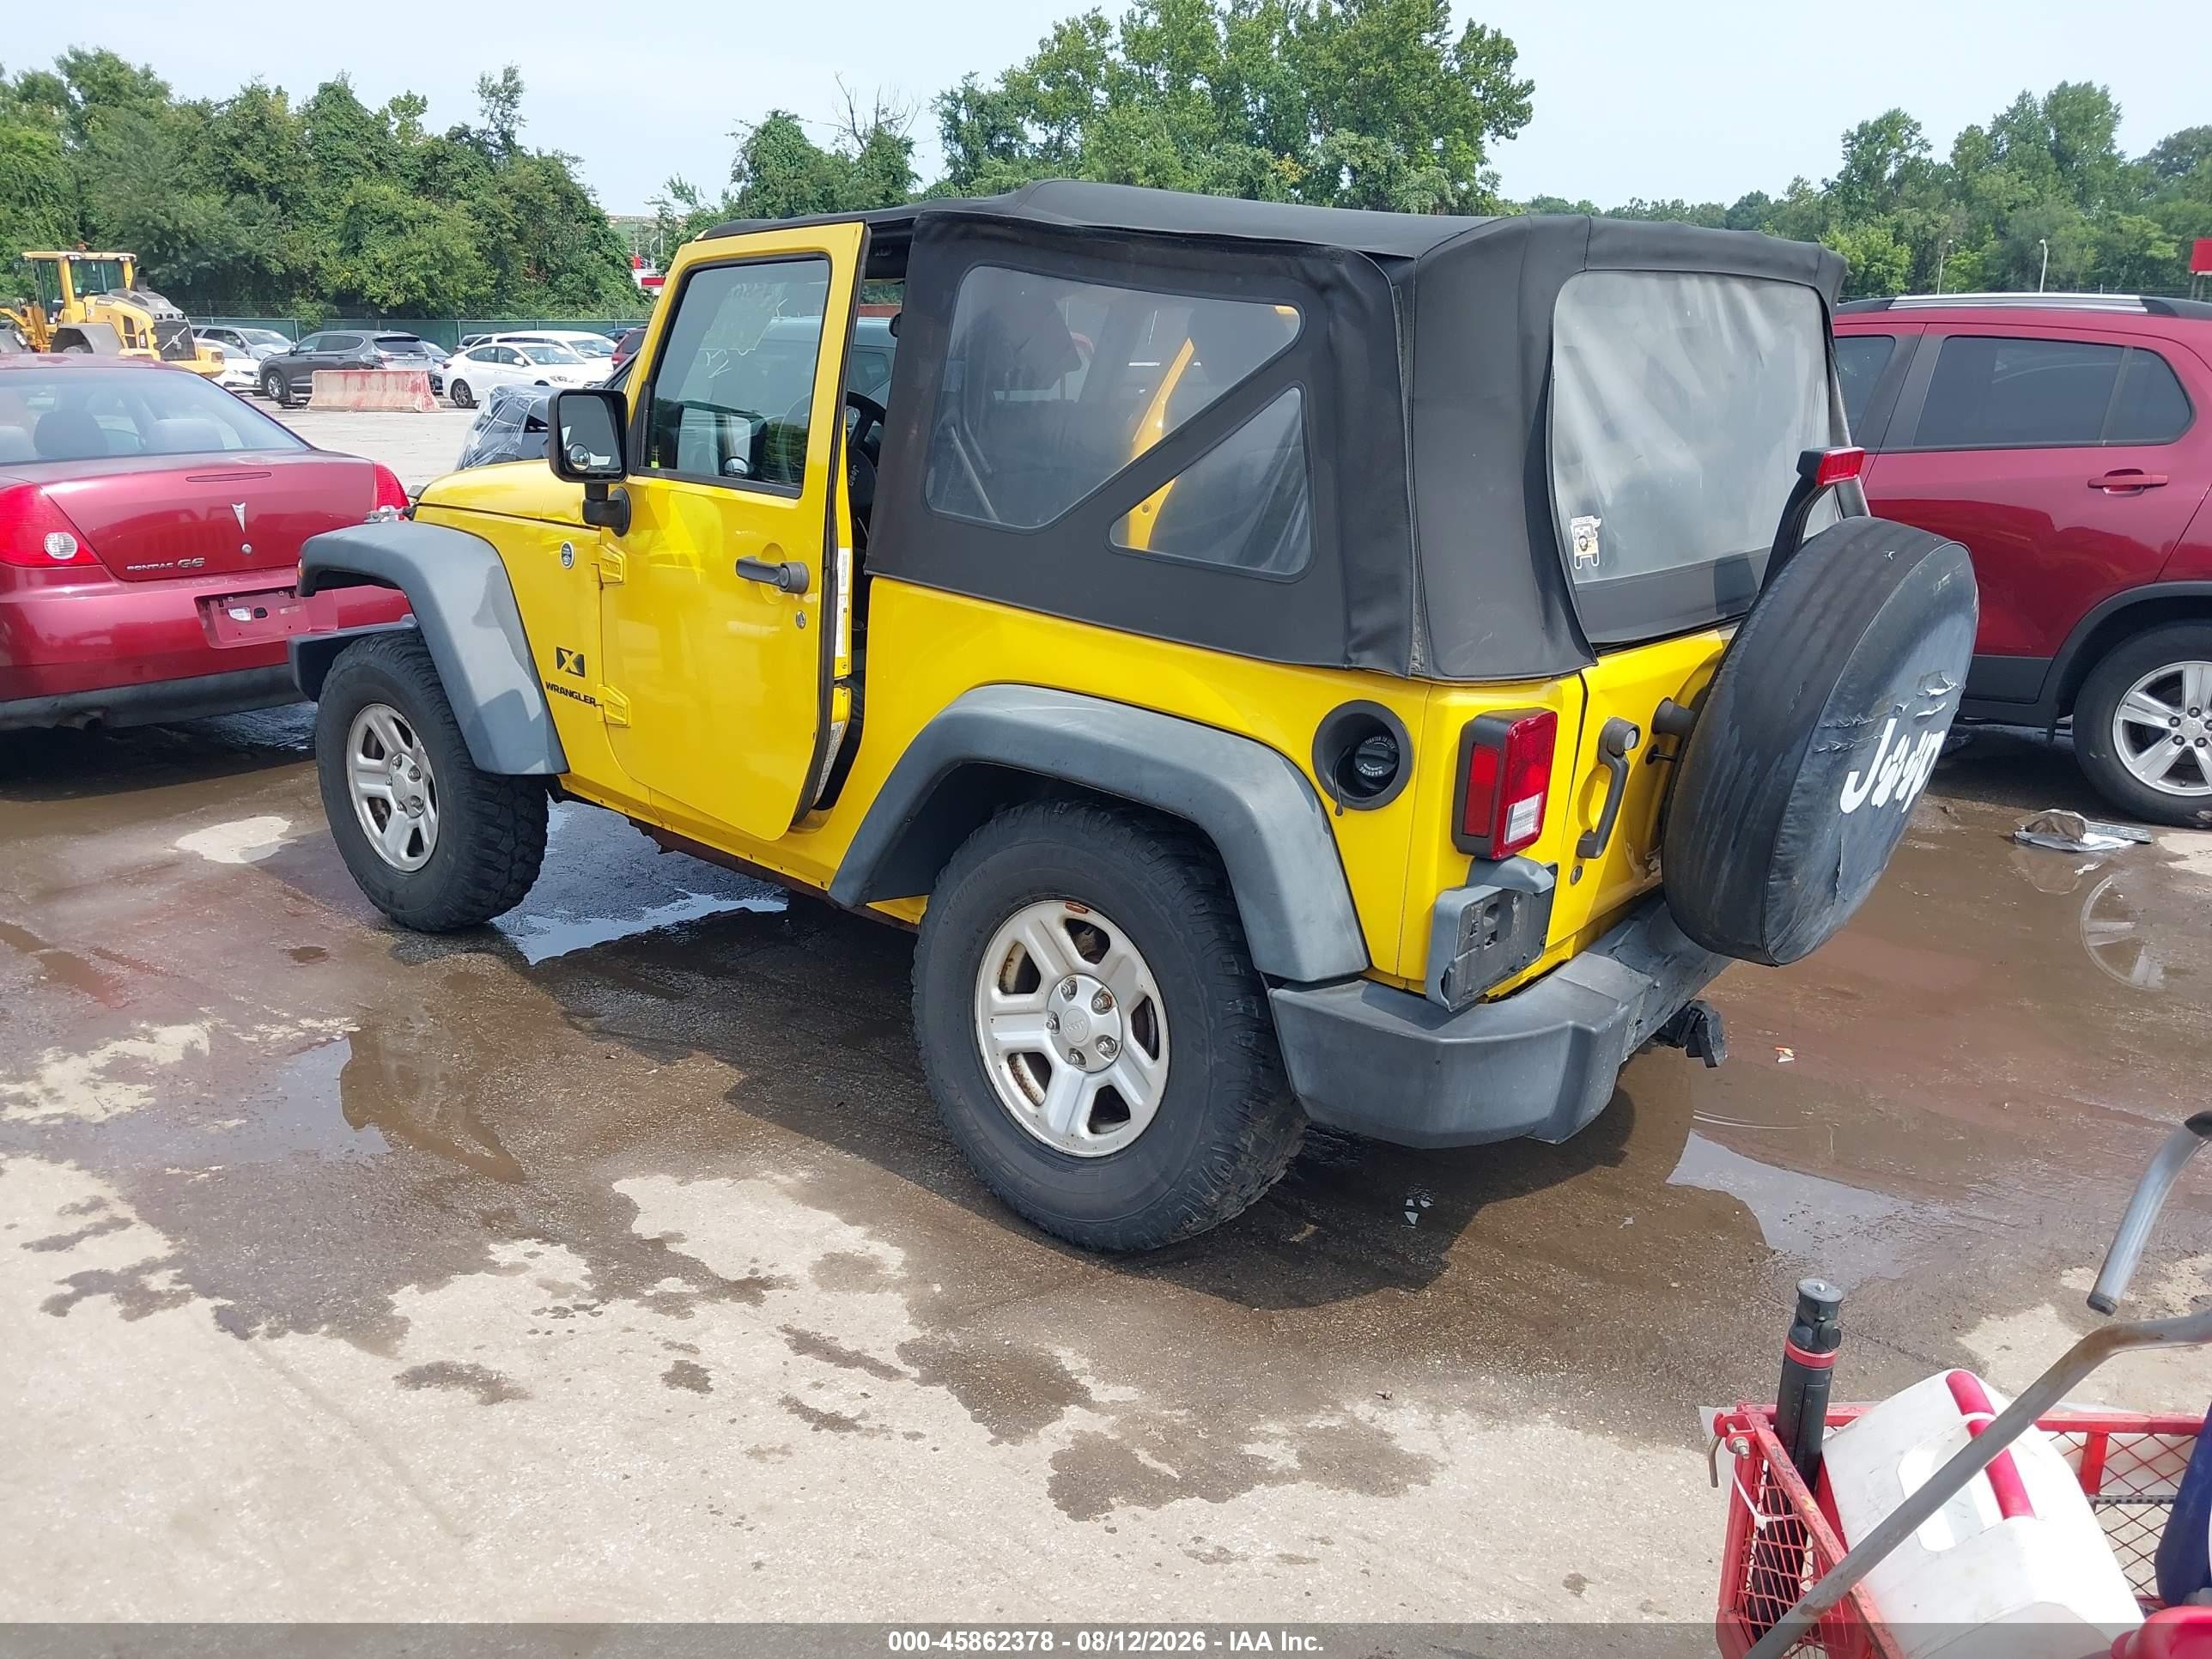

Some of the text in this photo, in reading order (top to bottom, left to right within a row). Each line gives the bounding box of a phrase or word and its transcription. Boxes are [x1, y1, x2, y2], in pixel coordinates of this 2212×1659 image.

[177, 557, 205, 568] G6
[556, 647, 585, 677] X
[545, 681, 597, 708] WRANGLER
